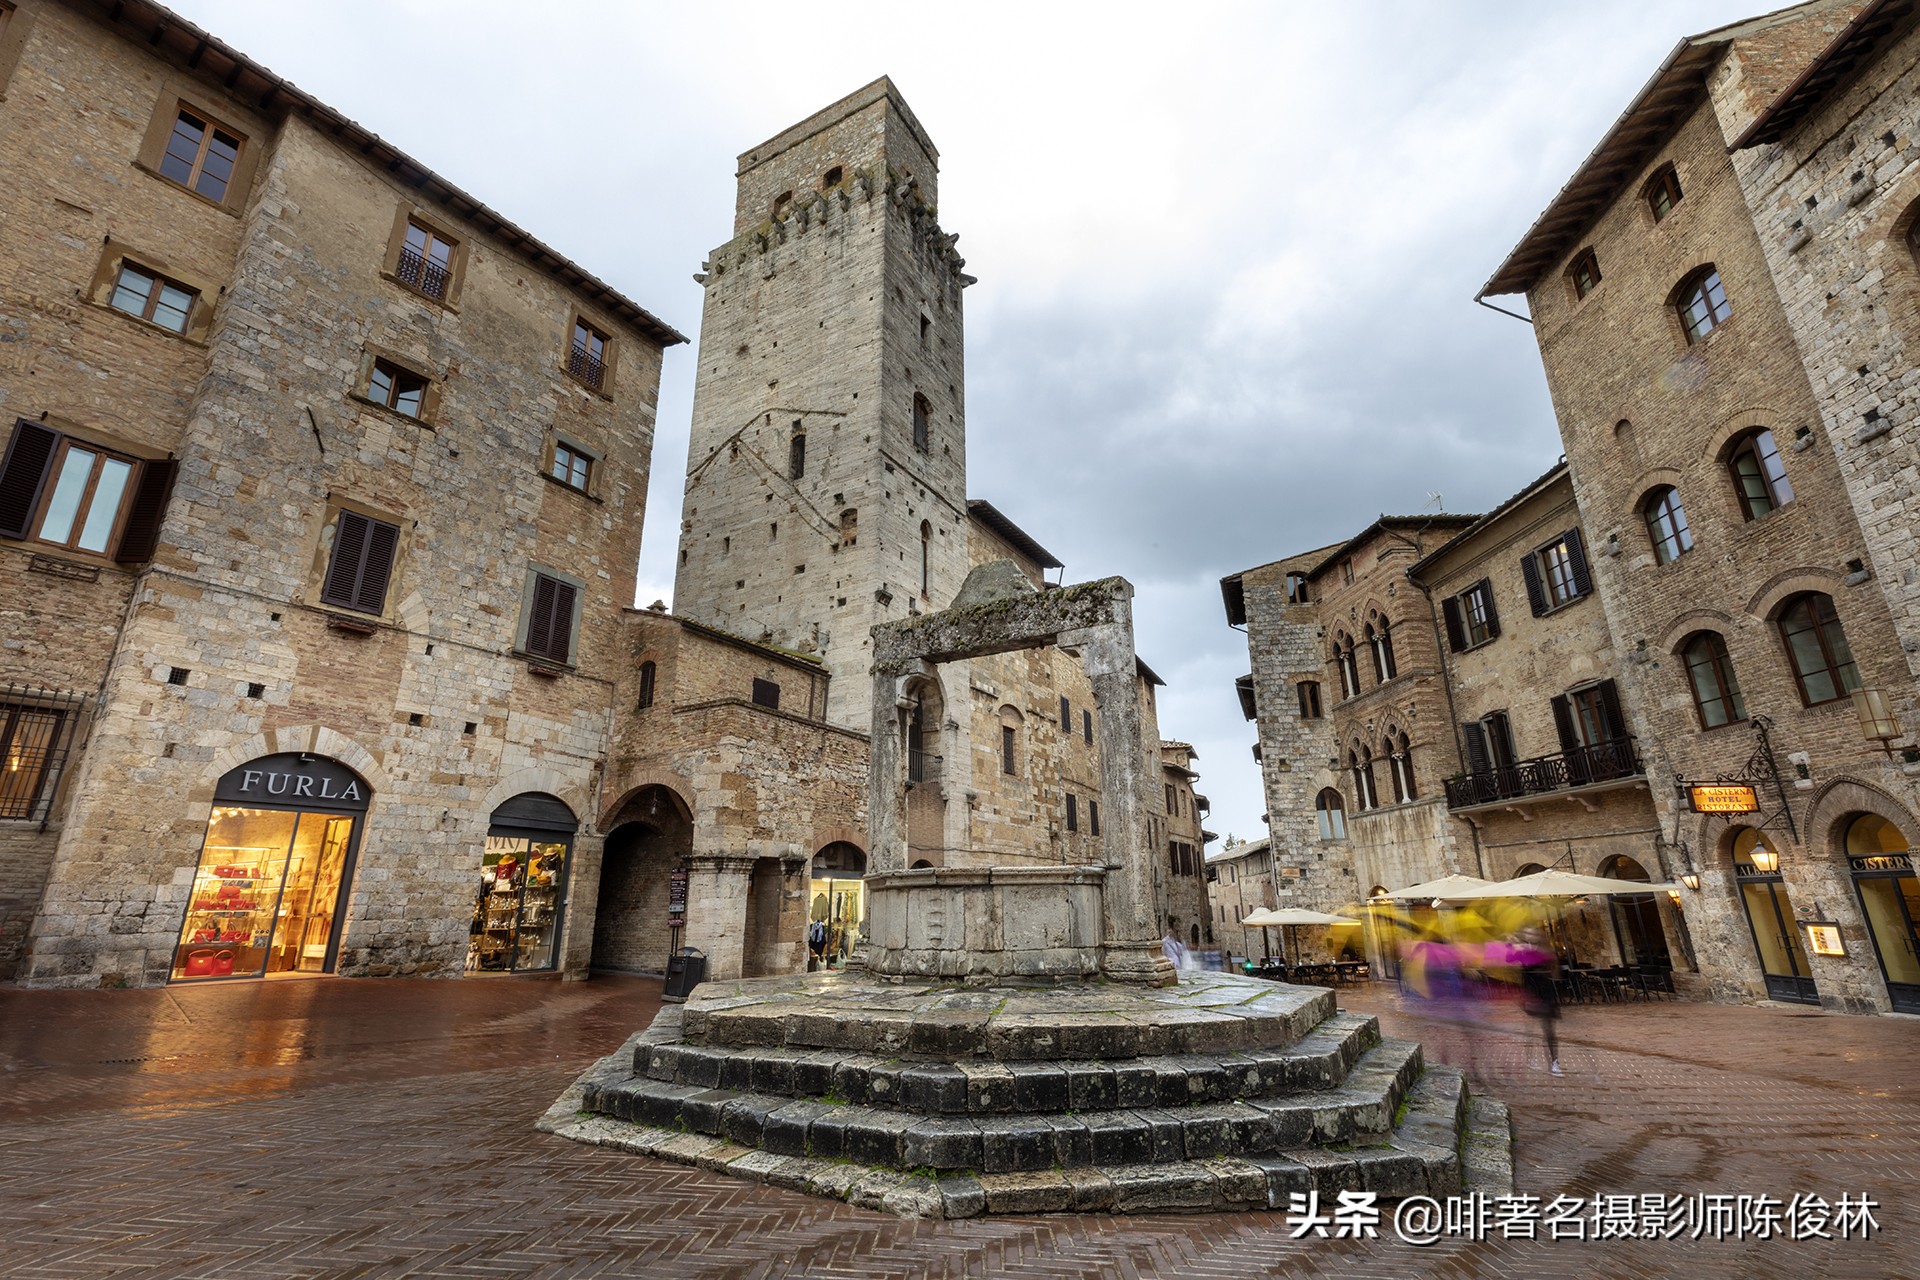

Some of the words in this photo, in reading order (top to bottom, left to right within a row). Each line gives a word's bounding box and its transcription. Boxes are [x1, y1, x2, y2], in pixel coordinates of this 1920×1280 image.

[239, 769, 361, 801] FURLA
[1693, 788, 1706, 796] LA
[1708, 788, 1753, 796] CISTERNA
